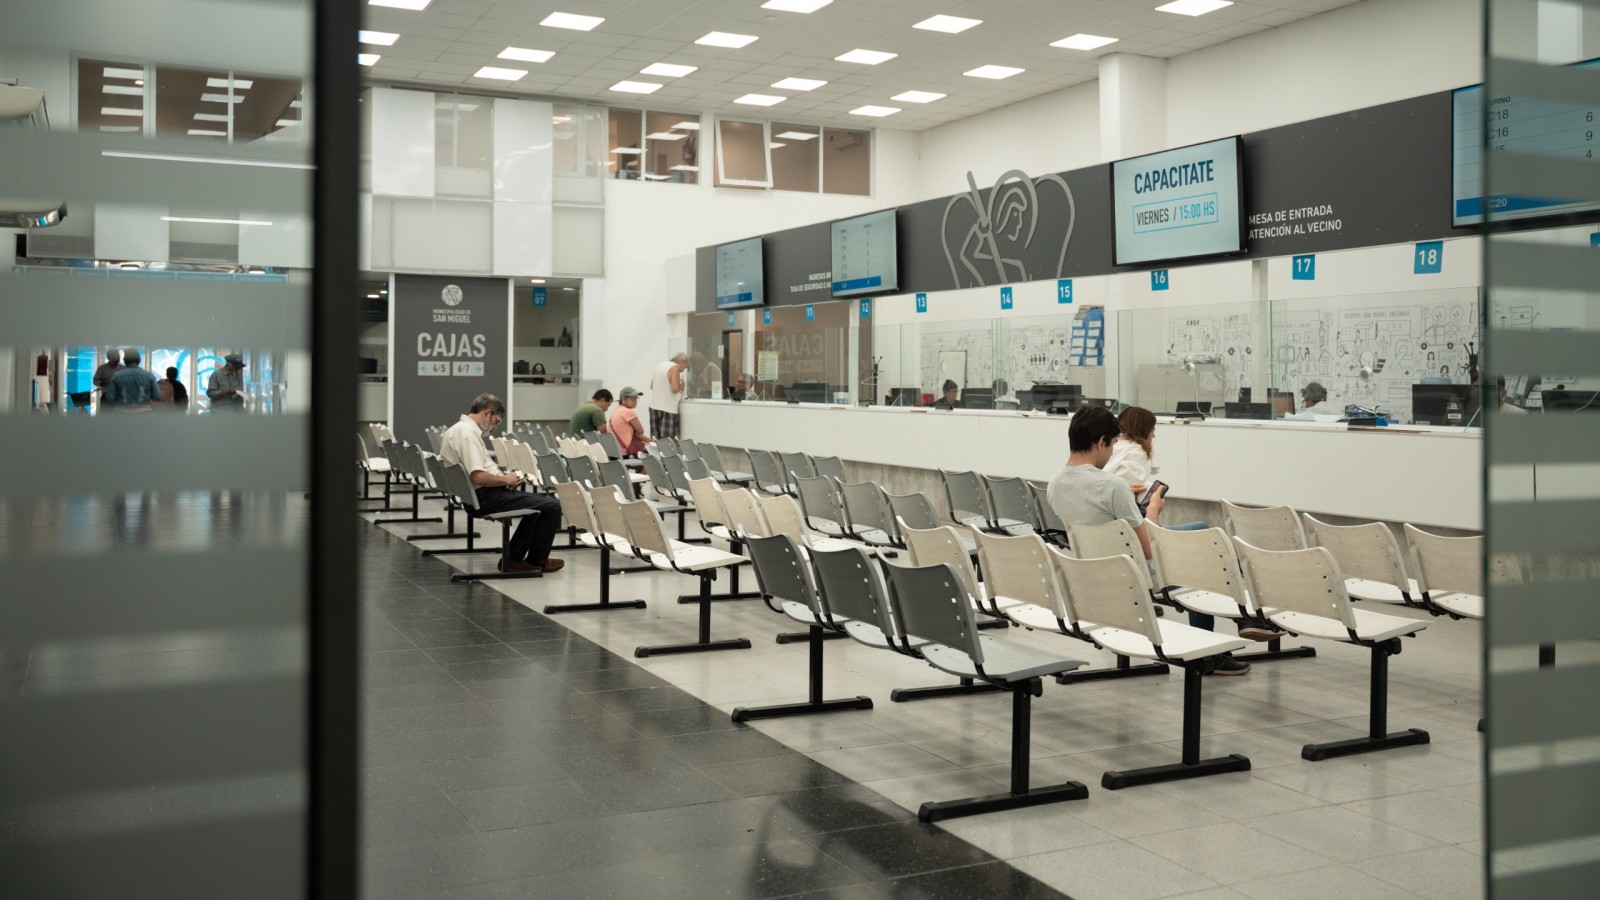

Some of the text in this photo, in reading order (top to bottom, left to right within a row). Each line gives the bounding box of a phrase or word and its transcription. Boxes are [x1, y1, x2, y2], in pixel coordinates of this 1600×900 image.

[1489, 96, 1511, 106] URNO
[1488, 109, 1593, 122] C18 6
[1488, 127, 1593, 141] C16 9
[1585, 149, 1592, 159] 4
[1134, 159, 1214, 194] CAPACITATE
[1488, 198, 1507, 208] C20
[1136, 201, 1215, 226] VIERNES / 15:00 HS
[1248, 204, 1333, 225] MESA DE ENTRADA
[1248, 219, 1342, 240] ATENCIÓN AL VECINO
[1419, 249, 1437, 266] 18
[1296, 258, 1311, 272] 17
[1153, 271, 1165, 284] 16
[1059, 286, 1070, 298] 15
[918, 297, 925, 308] 13
[1002, 293, 1010, 304] 14
[806, 308, 813, 317] 11
[862, 303, 868, 312] 12
[433, 314, 471, 323] SAN MIGUEL
[417, 332, 486, 358] CAJAS
[433, 364, 470, 373] 4/5 6/7
